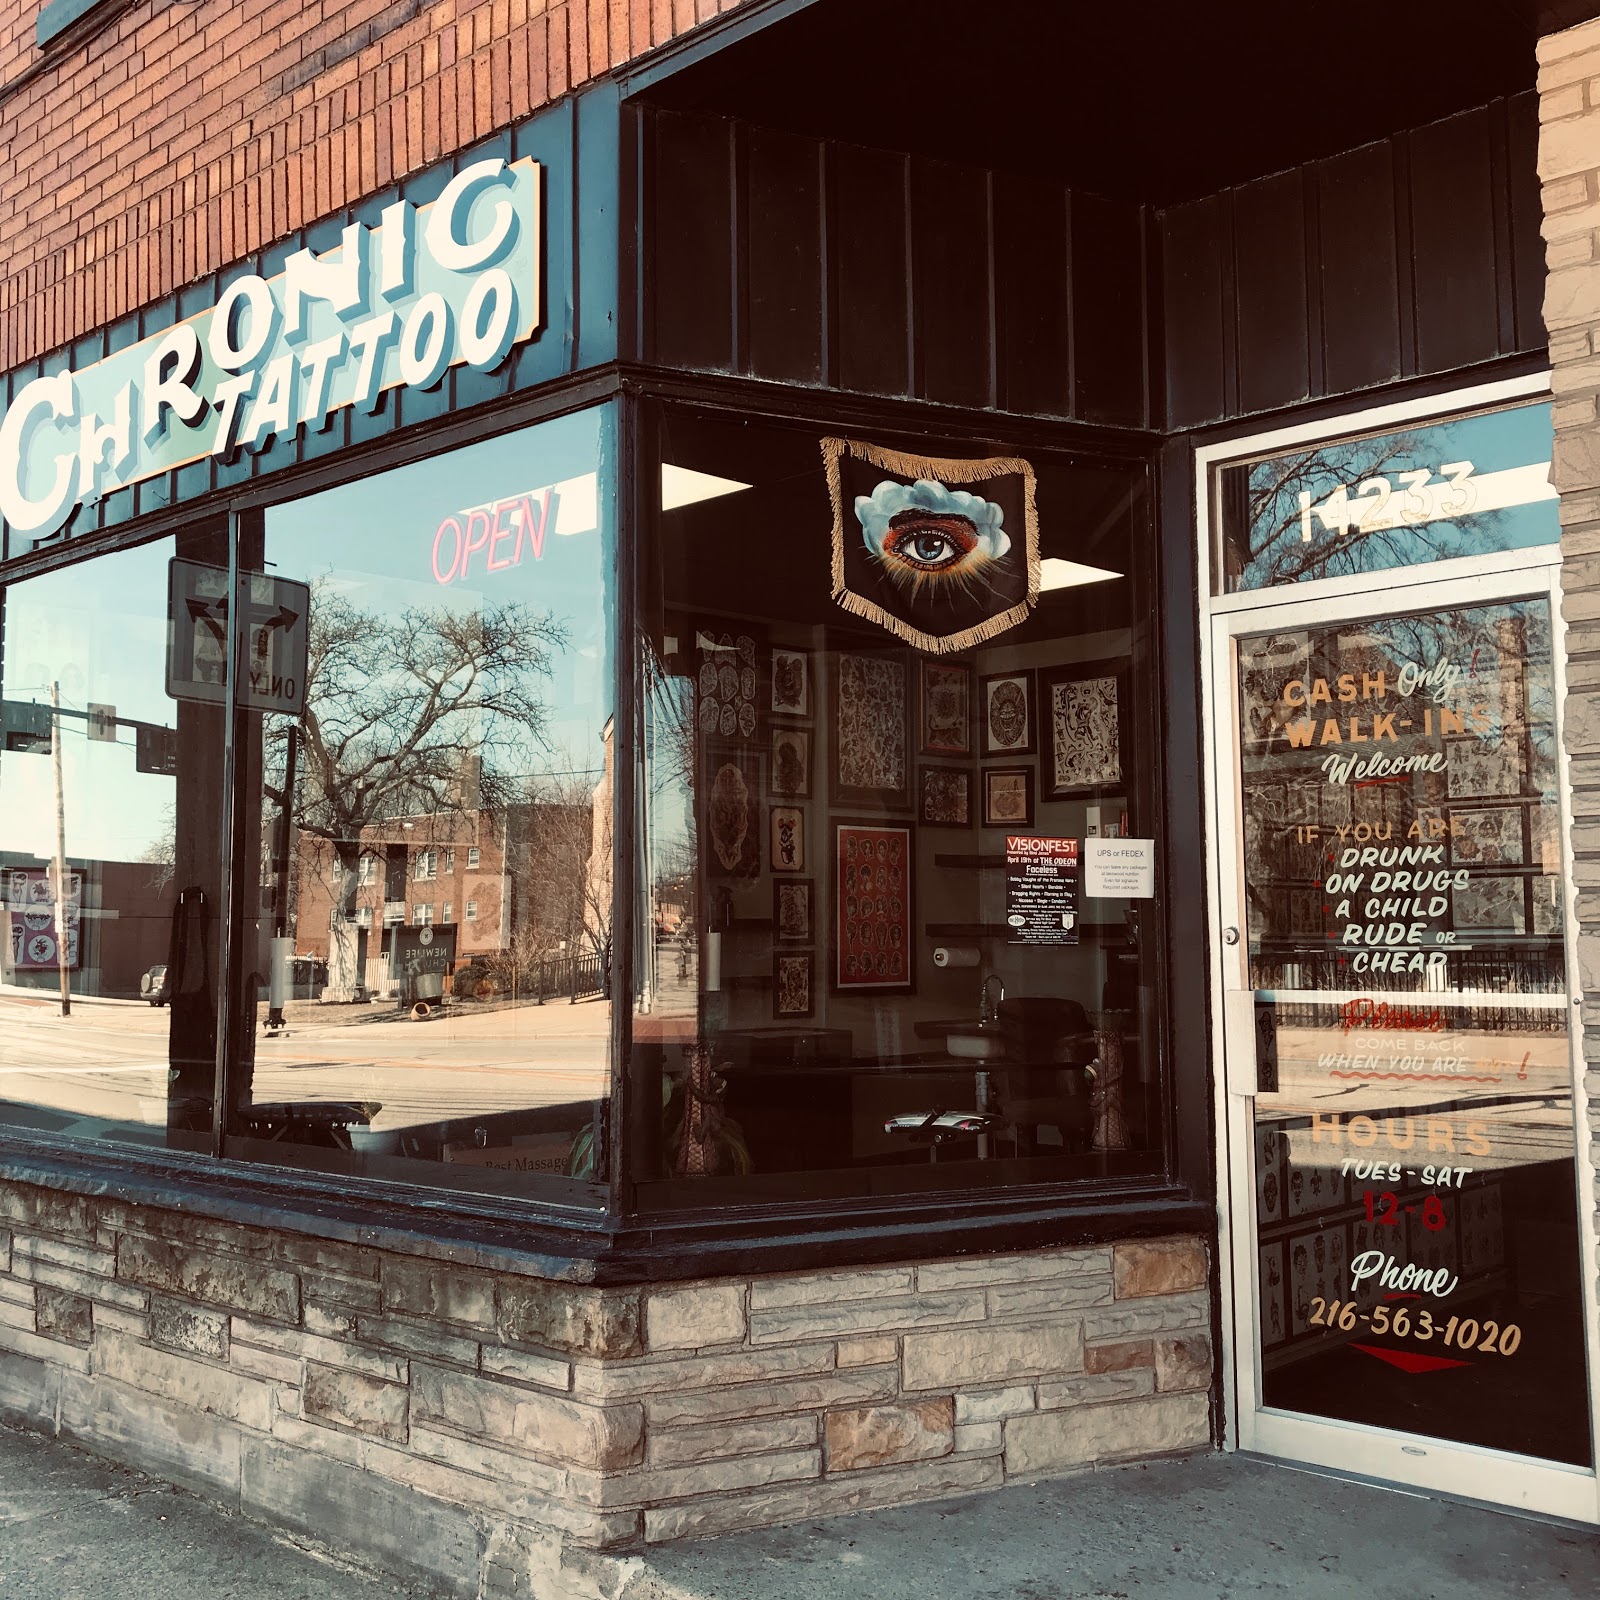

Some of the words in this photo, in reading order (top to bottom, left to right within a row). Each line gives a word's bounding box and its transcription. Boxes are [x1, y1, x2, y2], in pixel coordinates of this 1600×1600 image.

[0, 158, 520, 534] CHRONIC
[211, 268, 515, 457] TATTOO
[1299, 461, 1477, 542] 14233
[432, 490, 550, 584] OPEN
[1283, 671, 1385, 707] CASH
[1321, 752, 1448, 786] Welcome
[1297, 826, 1320, 844] IF
[1336, 821, 1392, 842] YOU
[1407, 816, 1468, 839] ARE
[1026, 865, 1058, 874] Faceless
[1040, 857, 1052, 865] THE
[1054, 858, 1077, 866] ODEON
[1340, 845, 1445, 868] DRUNK
[1325, 873, 1365, 894] ON
[1370, 869, 1470, 892] DRUGS
[1335, 899, 1350, 919] A
[1364, 897, 1448, 919] CHILD
[1342, 922, 1427, 945] RUDE
[1436, 931, 1456, 944] OR
[1340, 998, 1447, 1036] Please
[1355, 1037, 1407, 1050] COME
[1414, 1039, 1465, 1052] BACK
[1317, 1053, 1380, 1070] WHEN
[1389, 1055, 1425, 1071] YOU
[1432, 1056, 1469, 1073] ARE
[1311, 1111, 1492, 1157] HOURS
[515, 1157, 568, 1172] Massage
[1350, 1250, 1459, 1297] Phone
[1309, 1297, 1522, 1356] 216-563-1020
